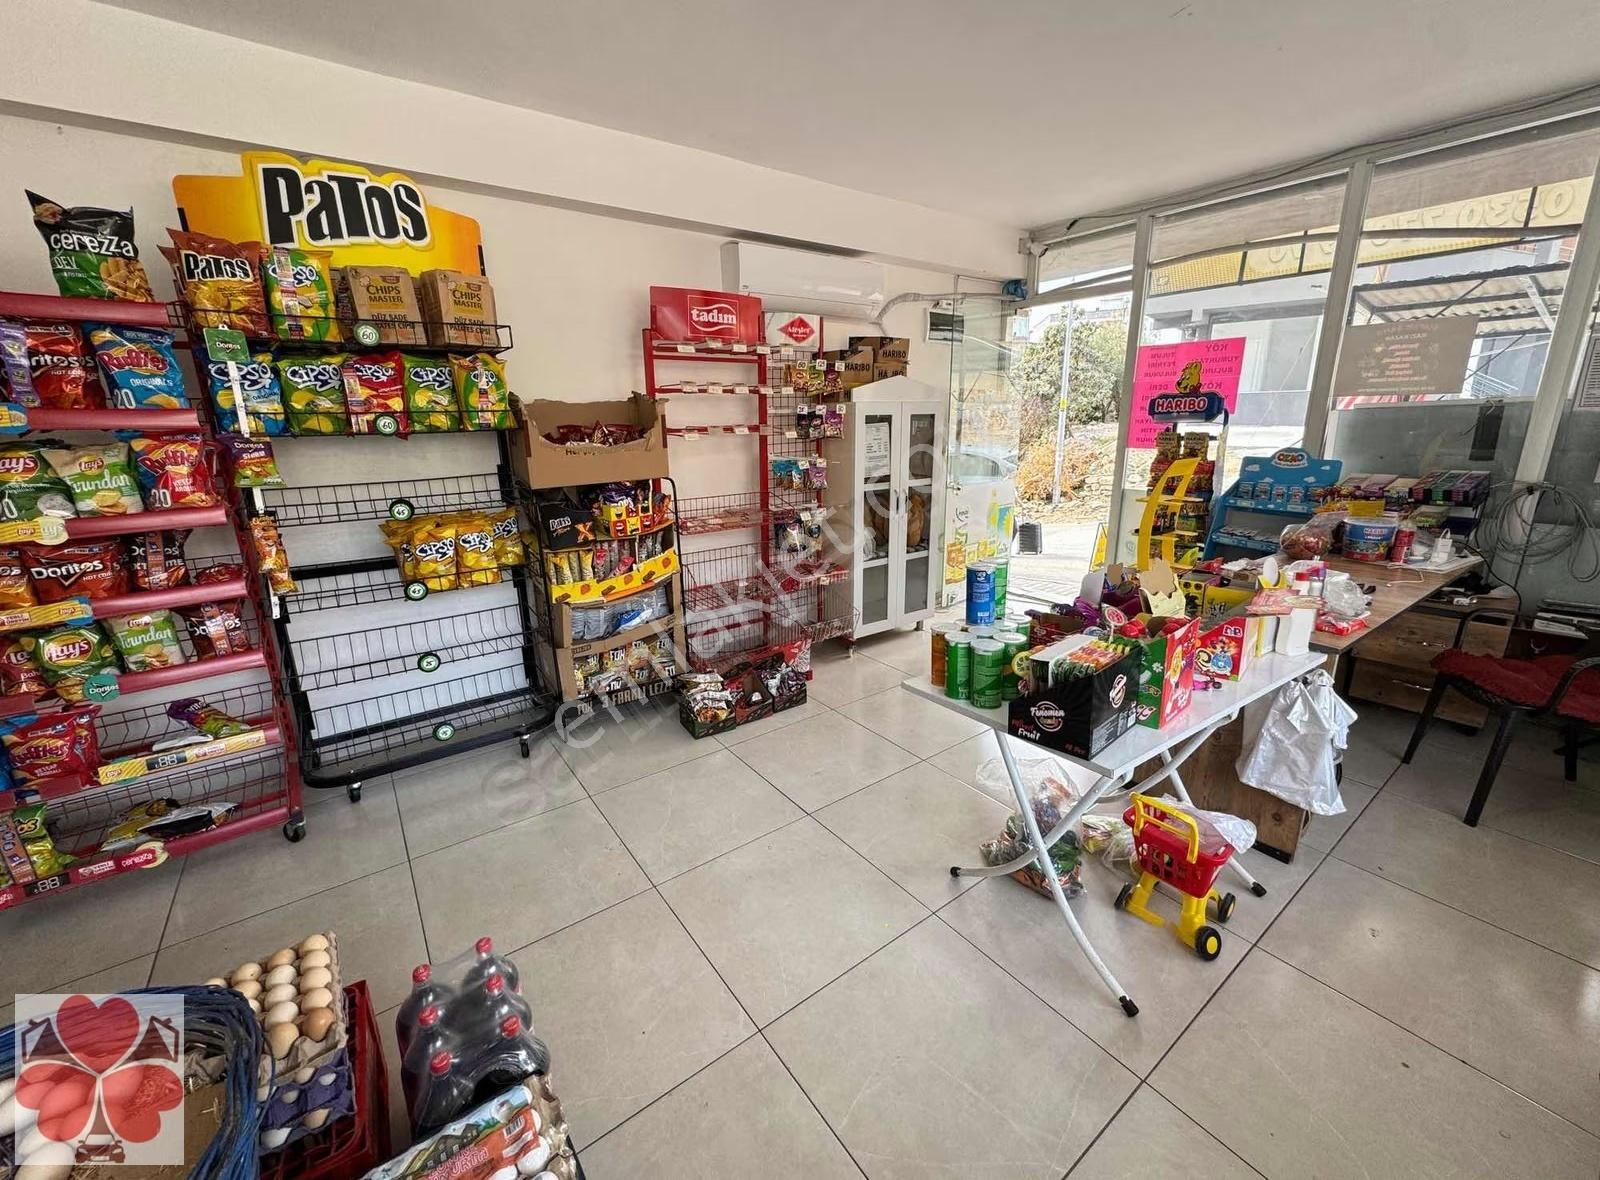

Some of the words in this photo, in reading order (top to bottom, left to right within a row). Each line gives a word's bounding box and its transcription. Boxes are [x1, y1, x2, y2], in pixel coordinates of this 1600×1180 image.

[50, 232, 135, 257] cerezza
[366, 284, 401, 295] CHIPS
[452, 289, 482, 301] CHIPS
[368, 295, 404, 304] MASTER
[453, 300, 483, 309] MASTER
[361, 330, 374, 341] 60
[882, 349, 907, 359] HARIBO
[31, 356, 79, 367] ritos
[844, 362, 871, 372] HARIBO
[878, 368, 904, 377] HAIBO
[1155, 396, 1208, 412] HARIBO
[382, 420, 393, 430] 60
[151, 489, 172, 508] 20
[31, 559, 104, 580] Doritos
[1017, 727, 1041, 741] Fruit
